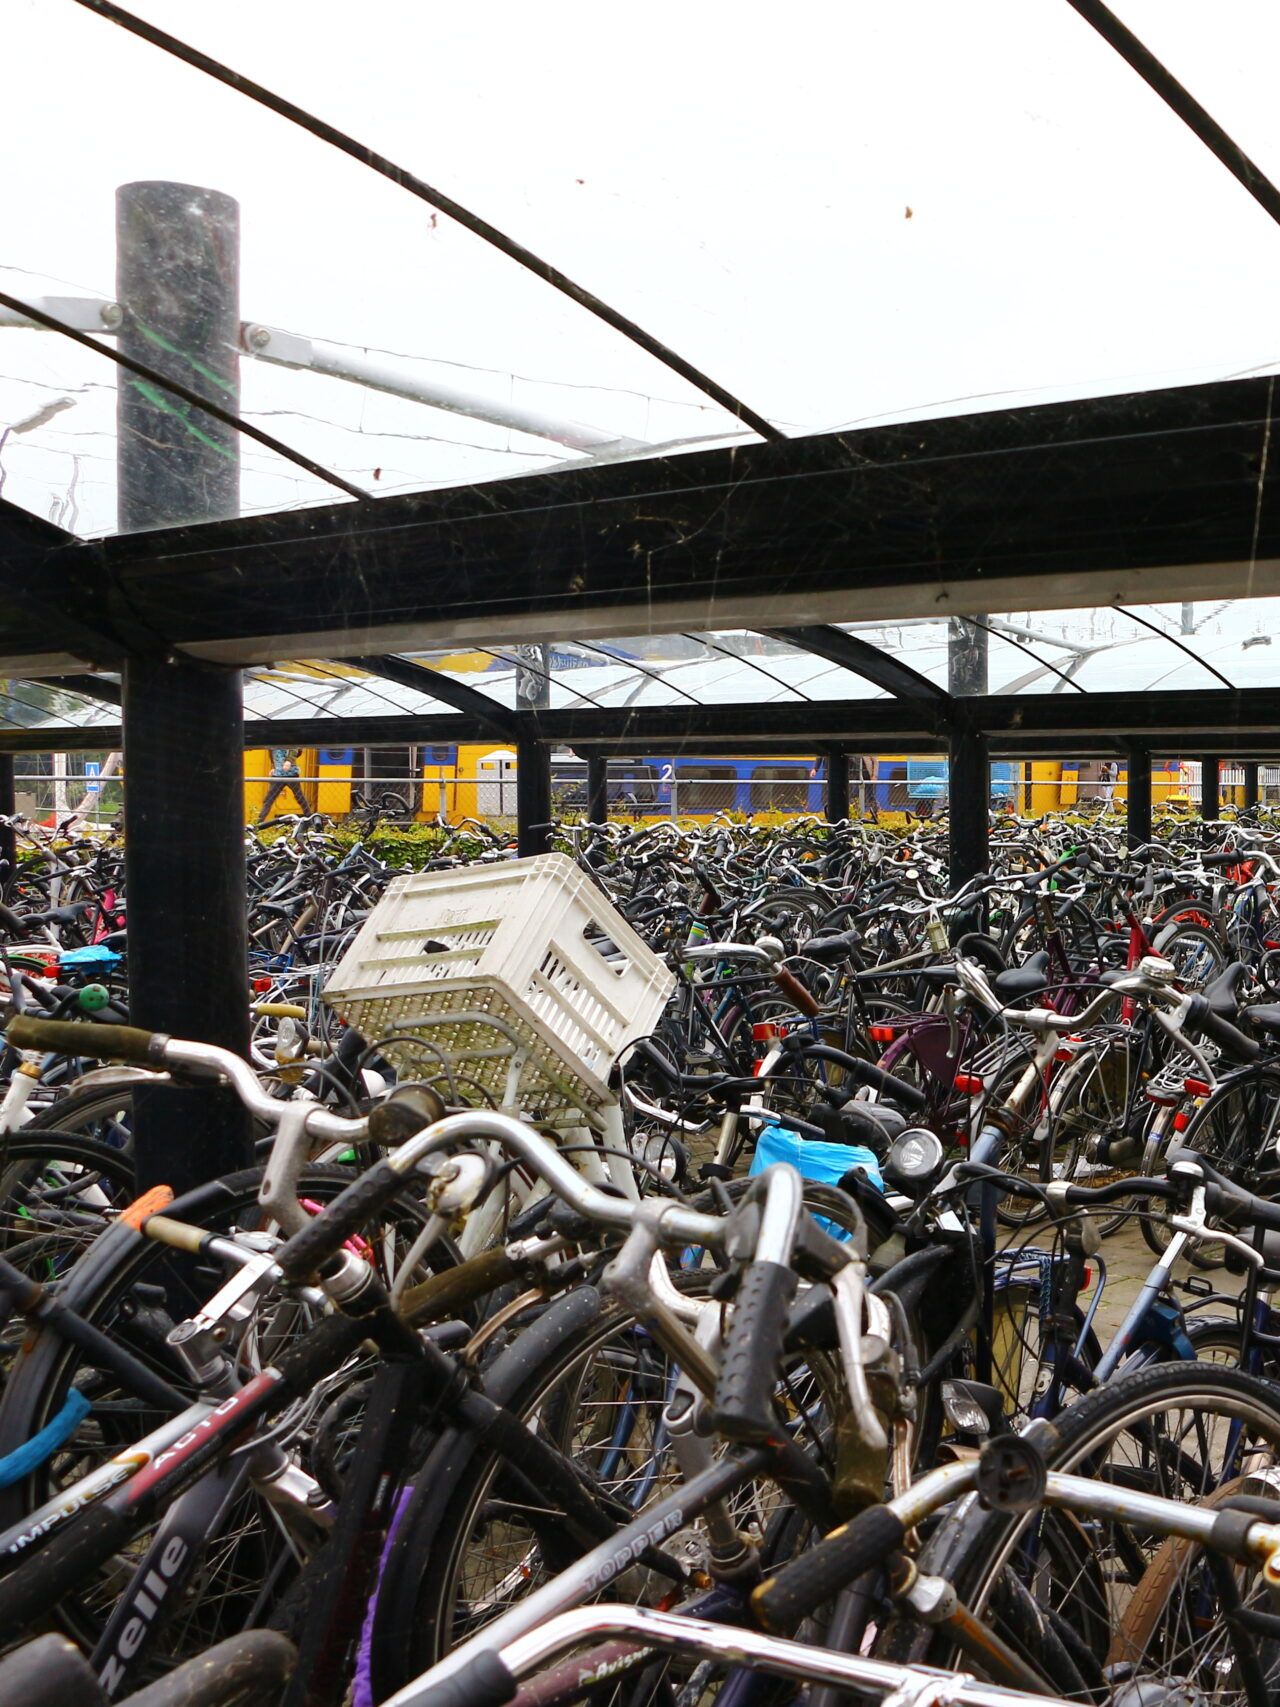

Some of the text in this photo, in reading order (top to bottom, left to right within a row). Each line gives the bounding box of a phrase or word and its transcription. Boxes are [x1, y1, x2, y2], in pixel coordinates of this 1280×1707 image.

[662, 764, 672, 780] 2
[154, 1397, 238, 1470] ACTO
[9, 1469, 129, 1553] IMPULSE
[584, 1508, 683, 1592] TOPPER
[98, 1536, 188, 1696] zelle
